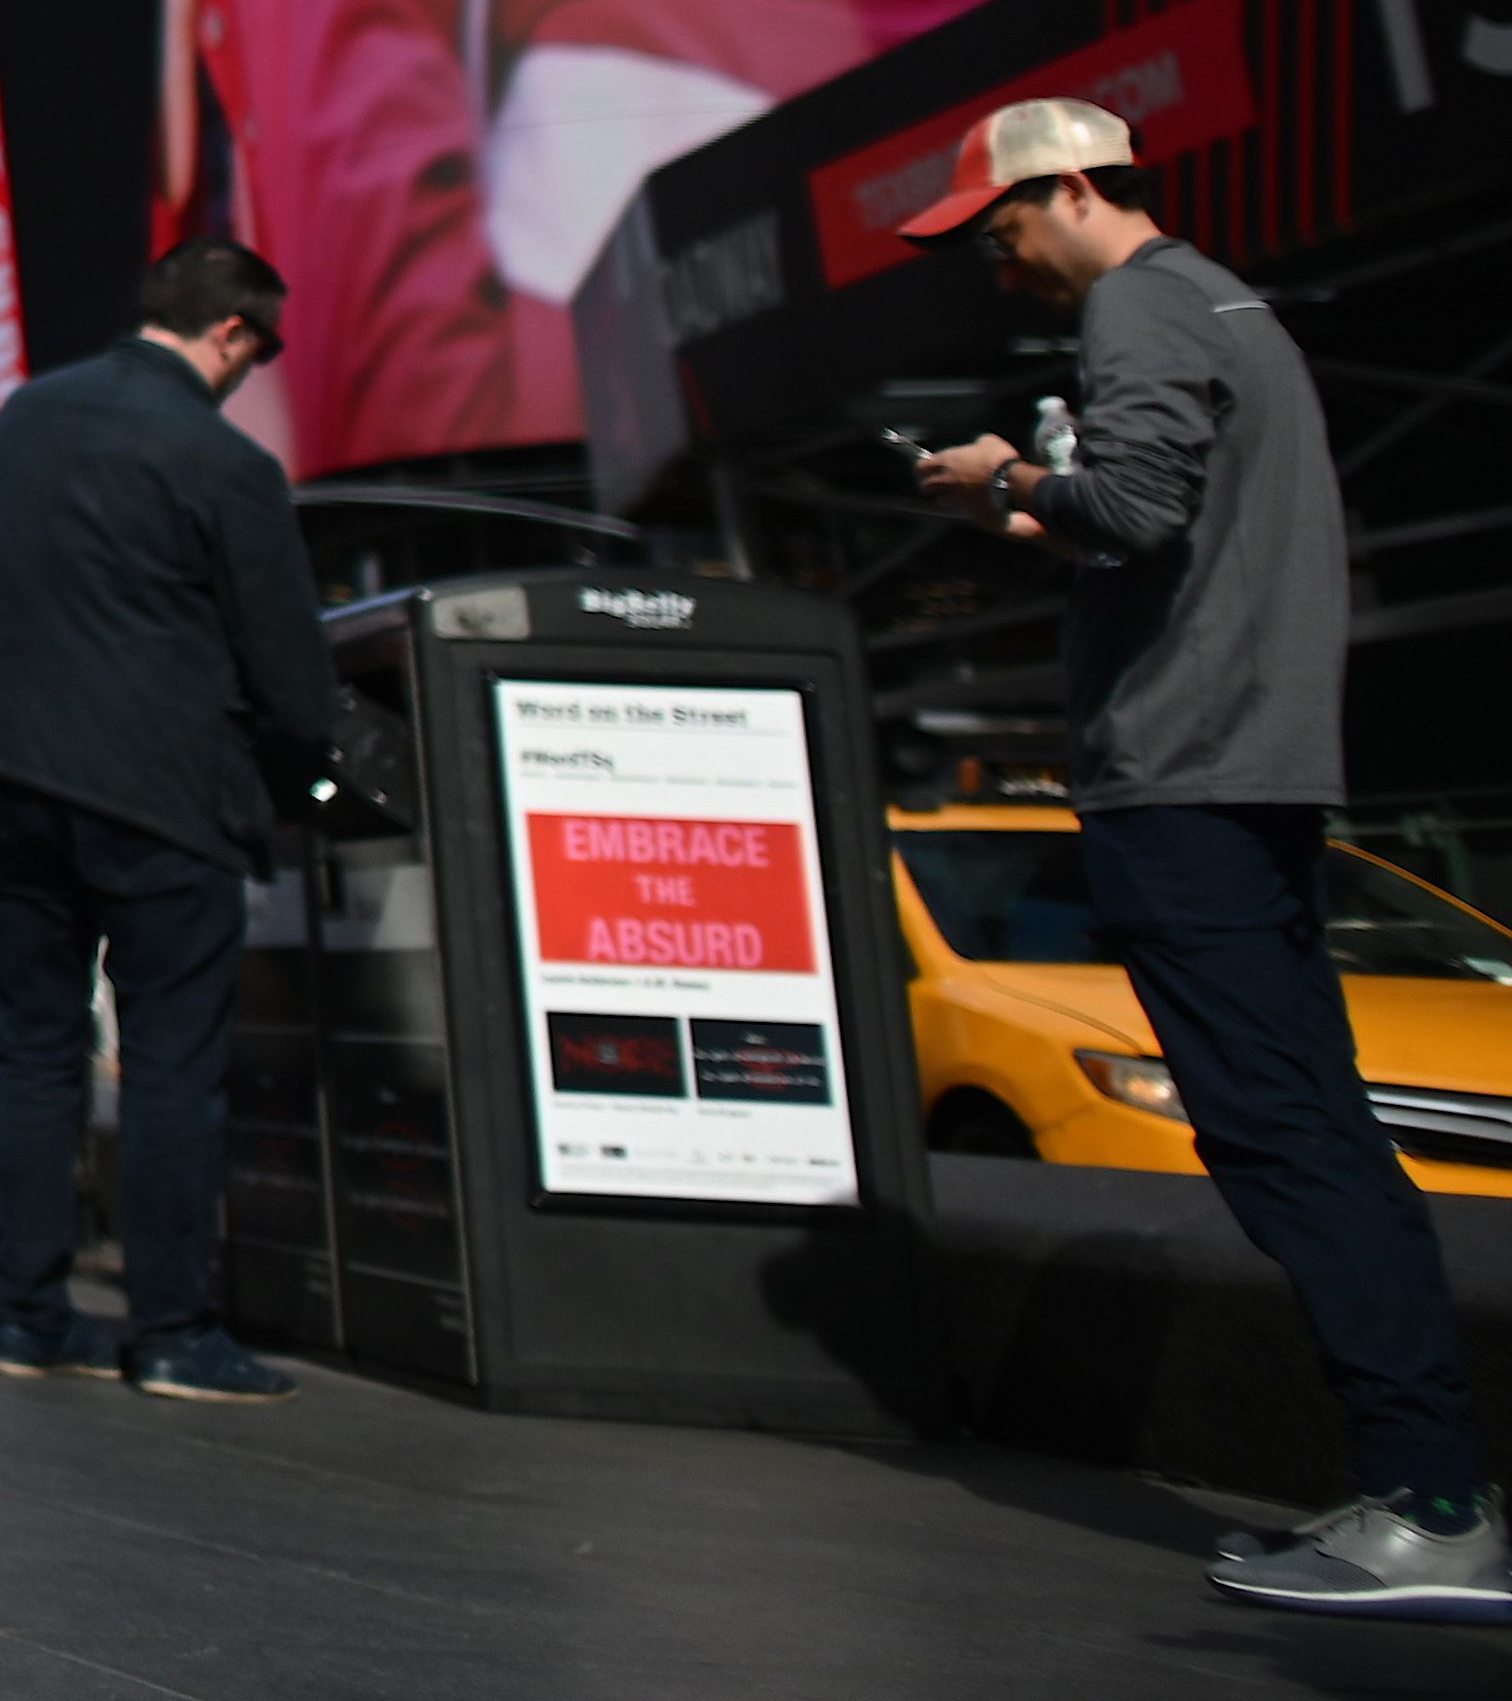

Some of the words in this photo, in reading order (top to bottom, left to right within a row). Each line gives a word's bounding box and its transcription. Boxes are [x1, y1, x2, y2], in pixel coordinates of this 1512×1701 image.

[516, 700, 581, 722] Word
[588, 705, 617, 722] on
[625, 702, 665, 725] the
[672, 705, 747, 728] Street
[562, 817, 771, 868] EMBRACE
[635, 872, 696, 908] THE
[586, 917, 765, 969] ABSURD
